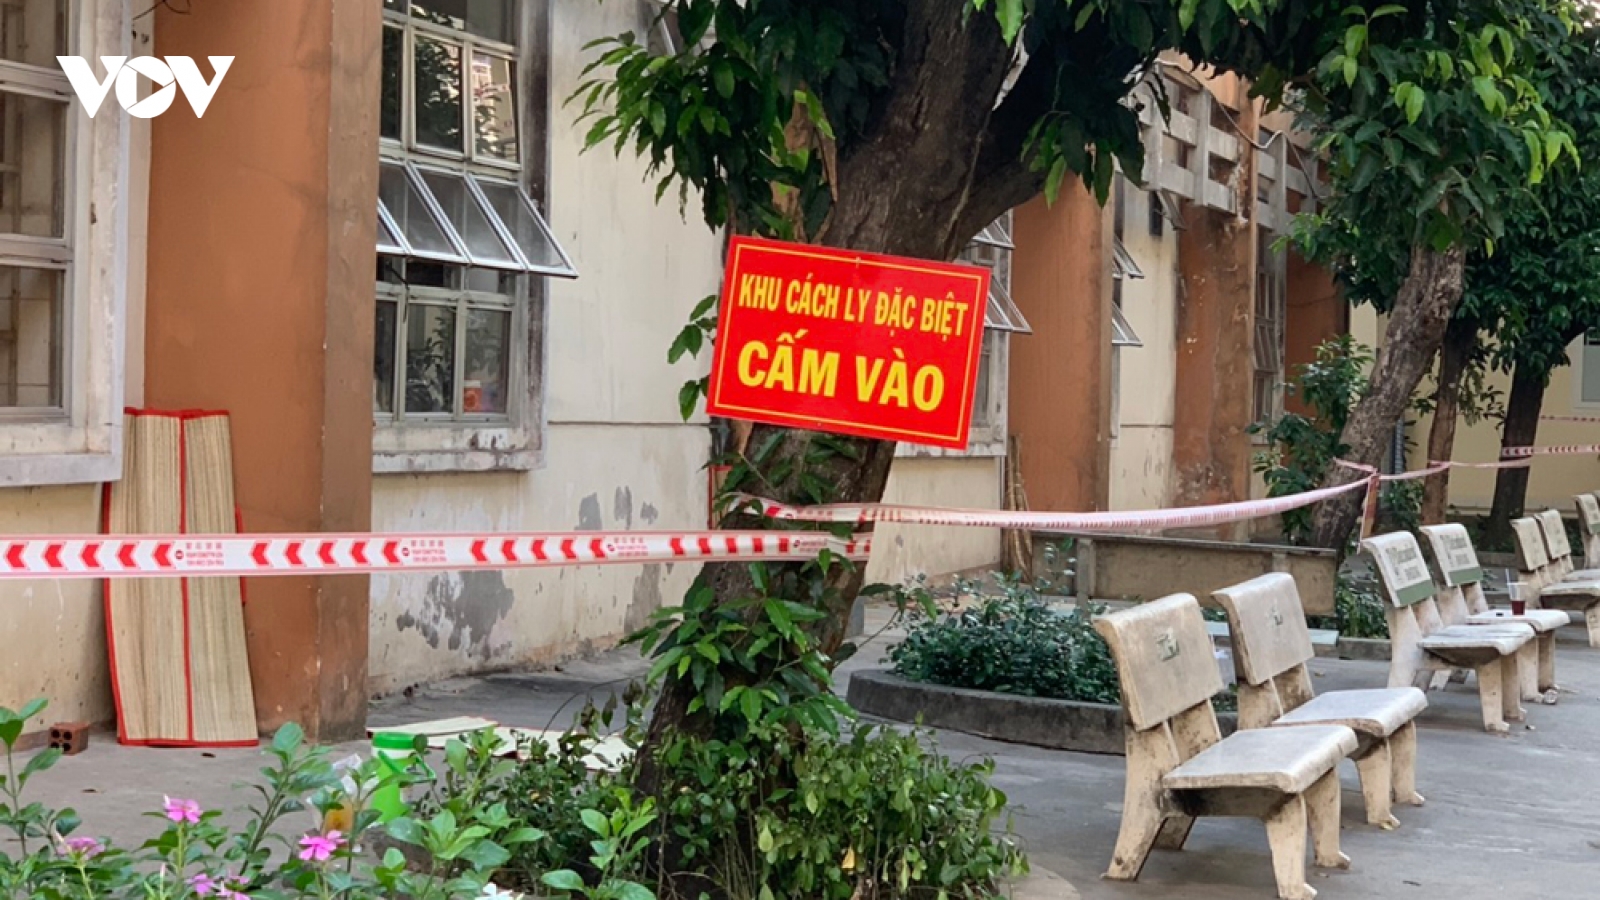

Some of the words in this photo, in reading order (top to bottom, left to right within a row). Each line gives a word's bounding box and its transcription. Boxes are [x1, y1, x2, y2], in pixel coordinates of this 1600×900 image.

[738, 273, 782, 311] KHU
[786, 272, 840, 319] CÁCH
[843, 287, 871, 322] LY
[874, 286, 916, 337] ĐẶC
[920, 291, 968, 341] BIỆT
[737, 328, 840, 398] CẤM
[855, 347, 945, 412] VÀO
